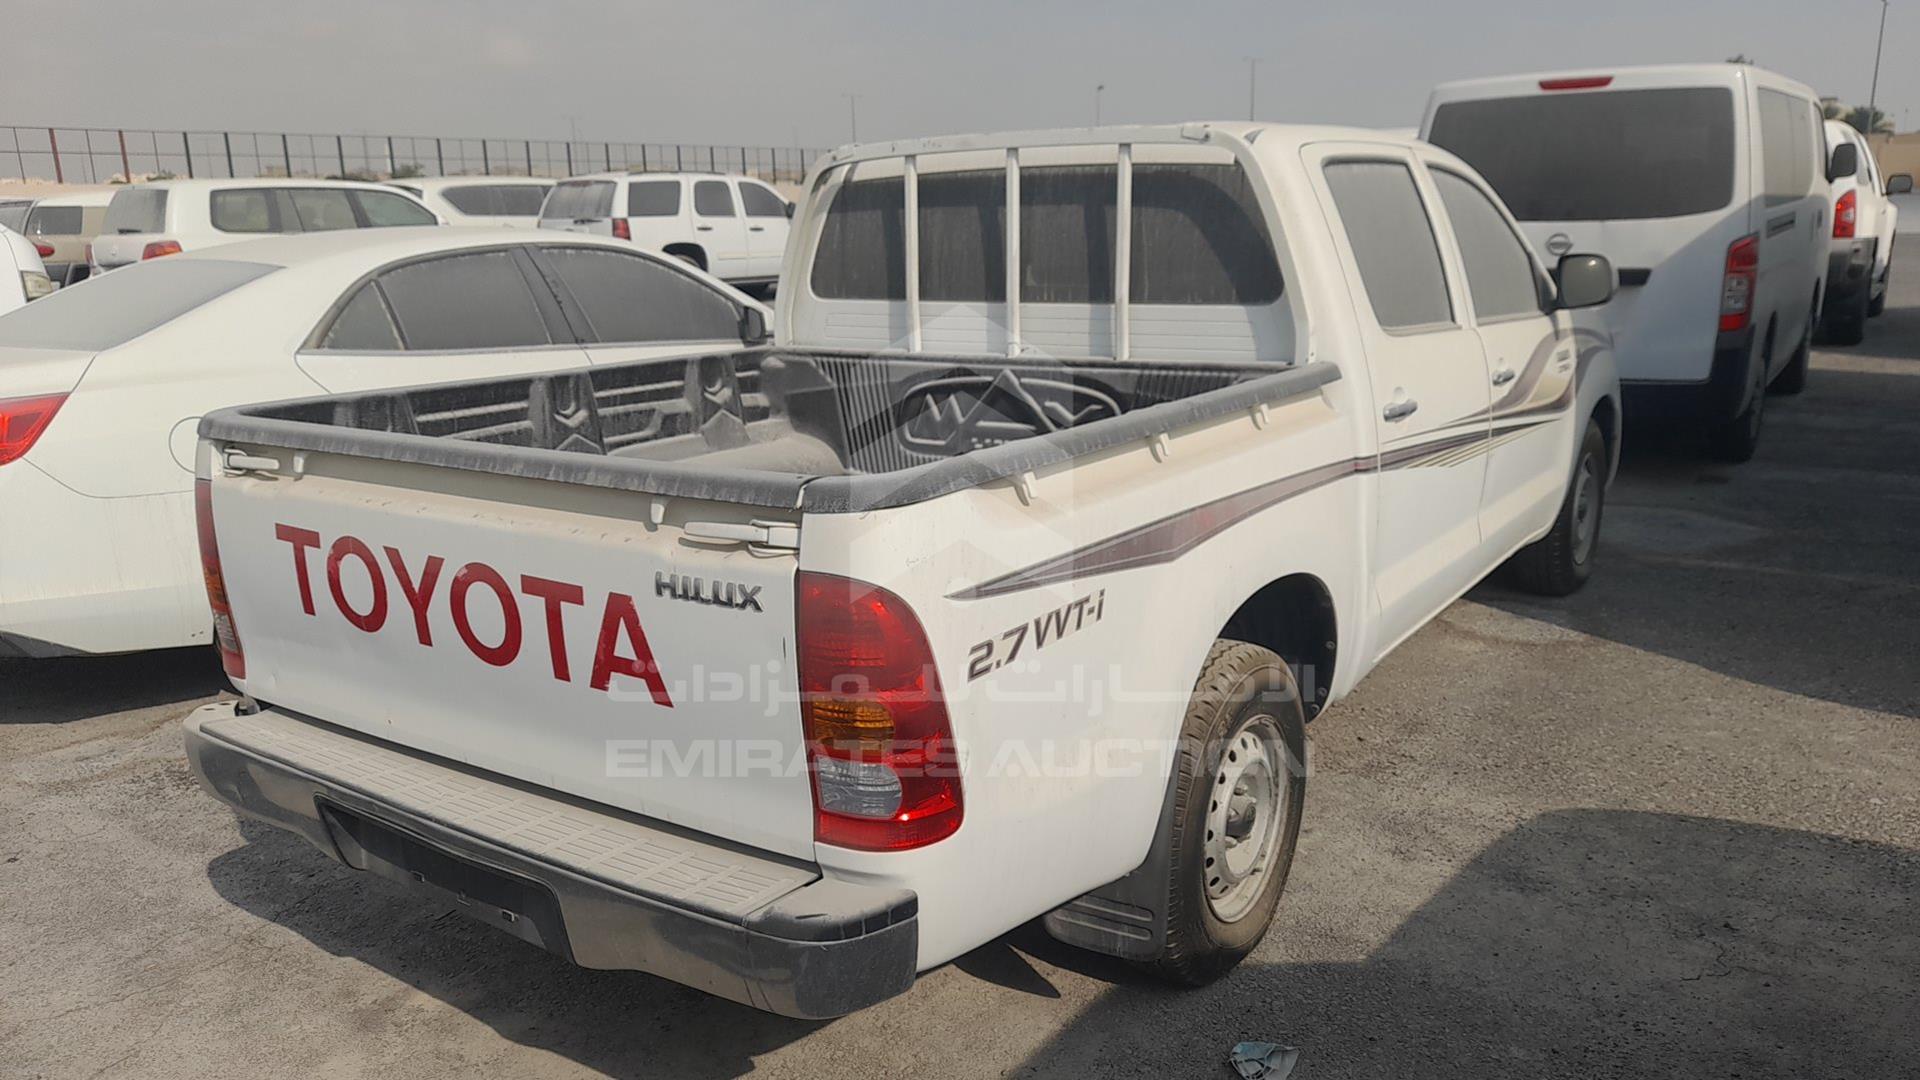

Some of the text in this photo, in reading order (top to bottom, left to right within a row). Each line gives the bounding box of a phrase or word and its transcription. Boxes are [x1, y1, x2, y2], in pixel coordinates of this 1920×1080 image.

[275, 523, 674, 708] TOYOTA
[655, 570, 764, 613] HILUX
[967, 622, 1030, 683] 2.7
